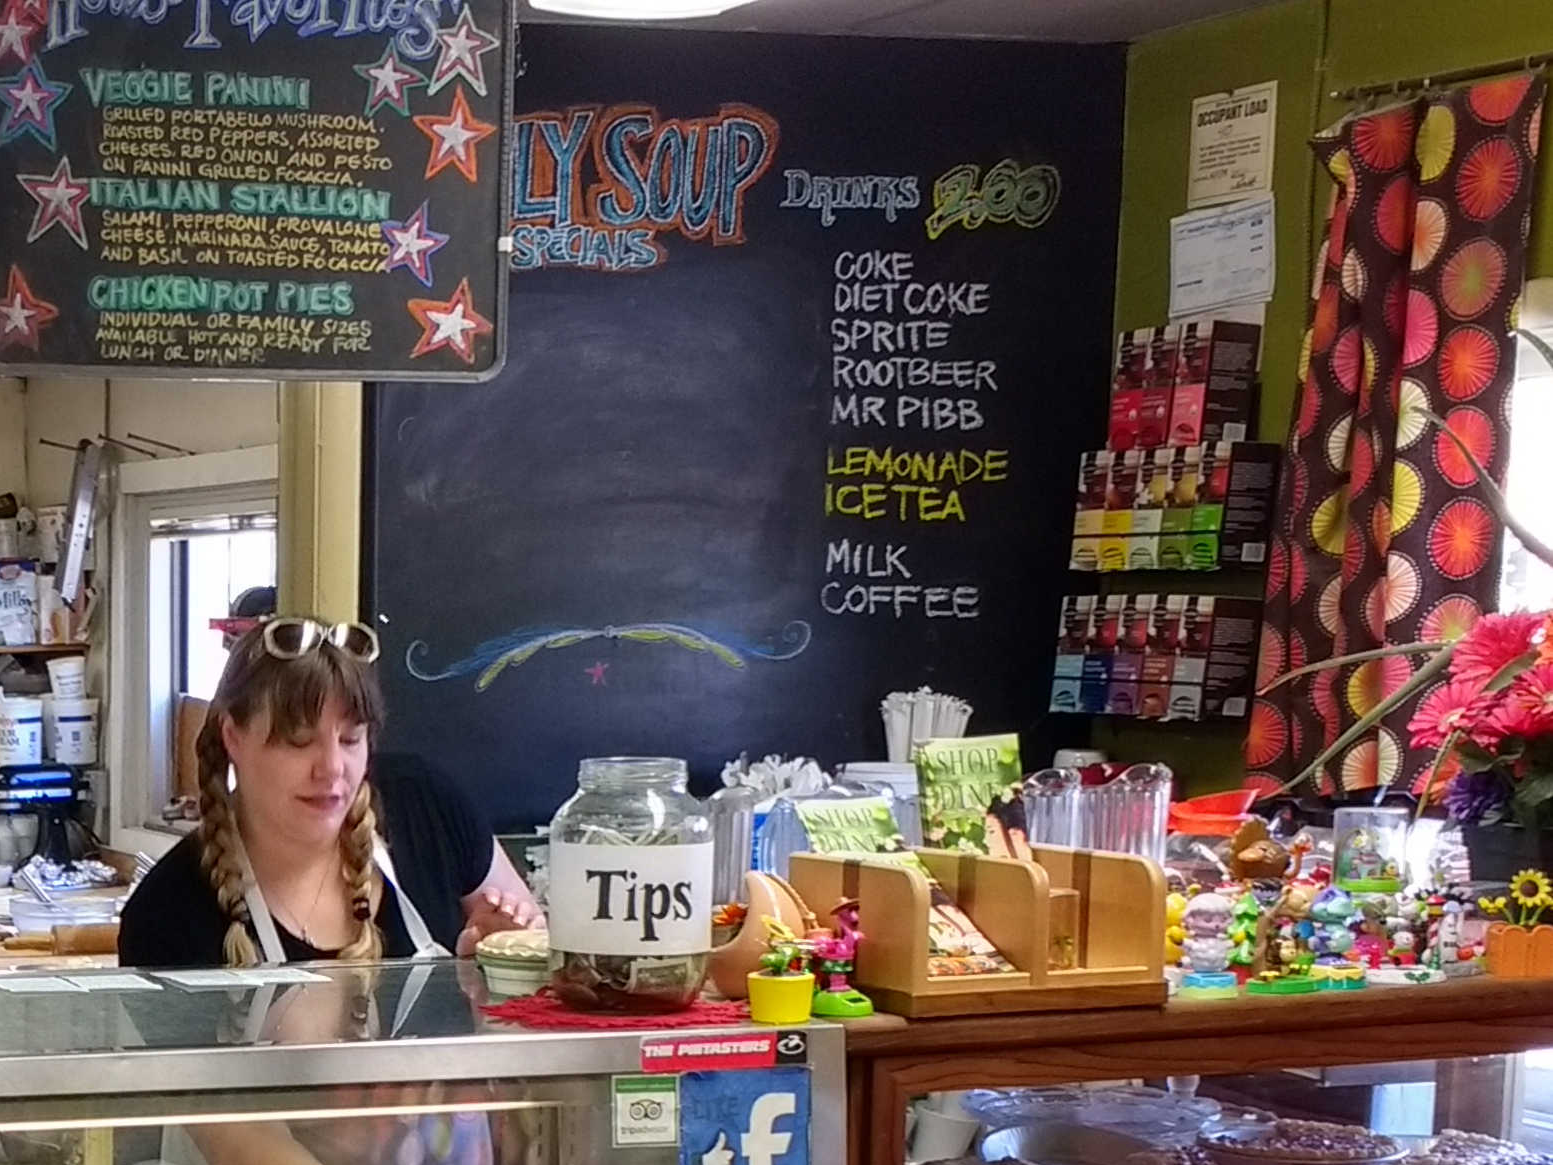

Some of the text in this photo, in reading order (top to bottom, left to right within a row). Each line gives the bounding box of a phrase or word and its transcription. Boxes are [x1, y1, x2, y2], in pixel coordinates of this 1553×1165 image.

[81, 68, 311, 109] VEGGIE PANINI
[102, 105, 165, 123] GRILLED
[171, 109, 272, 127] PORTABELLO
[102, 124, 165, 141] ROASTED
[170, 126, 204, 142] RED
[298, 130, 380, 150] ASSORTED
[102, 160, 126, 173] ON
[133, 160, 191, 177] PANINI
[198, 164, 271, 182] GRILLED
[181, 145, 215, 161] RED
[220, 148, 279, 164] ONION
[286, 152, 326, 168] AND
[334, 153, 392, 171] PESTO
[598, 113, 774, 240] SOUP
[90, 177, 391, 220] ITALIAN STALLION
[780, 169, 920, 226] DRINKS
[276, 217, 382, 238] PROVALONE
[100, 246, 132, 262] AND
[138, 248, 188, 266] BASIL
[197, 250, 220, 265] ON
[227, 251, 300, 269] TOASTED
[328, 238, 390, 257] TOMATO
[511, 224, 658, 270] SPECIALS
[833, 249, 914, 282] COKE
[88, 275, 355, 315] CHICKEN POT PIES
[833, 282, 990, 317] DIET COKE
[100, 312, 372, 337] INDIVIDUAL OR FAMILY SIZES
[188, 330, 219, 346] HOT
[219, 330, 258, 348] AND
[262, 332, 323, 354] READY
[333, 337, 372, 354] FOR
[830, 317, 952, 353] SPRITE
[101, 345, 266, 365] LUNCH OR DINNER
[831, 393, 984, 431] MR PIBB
[828, 446, 1009, 485] LEMONADE
[824, 483, 966, 521] ICE TEA
[826, 539, 911, 578] MILK
[820, 581, 980, 619] COFFEE
[935, 747, 999, 775] SHOP
[814, 806, 874, 829] SHOP
[586, 869, 692, 942] Tips
